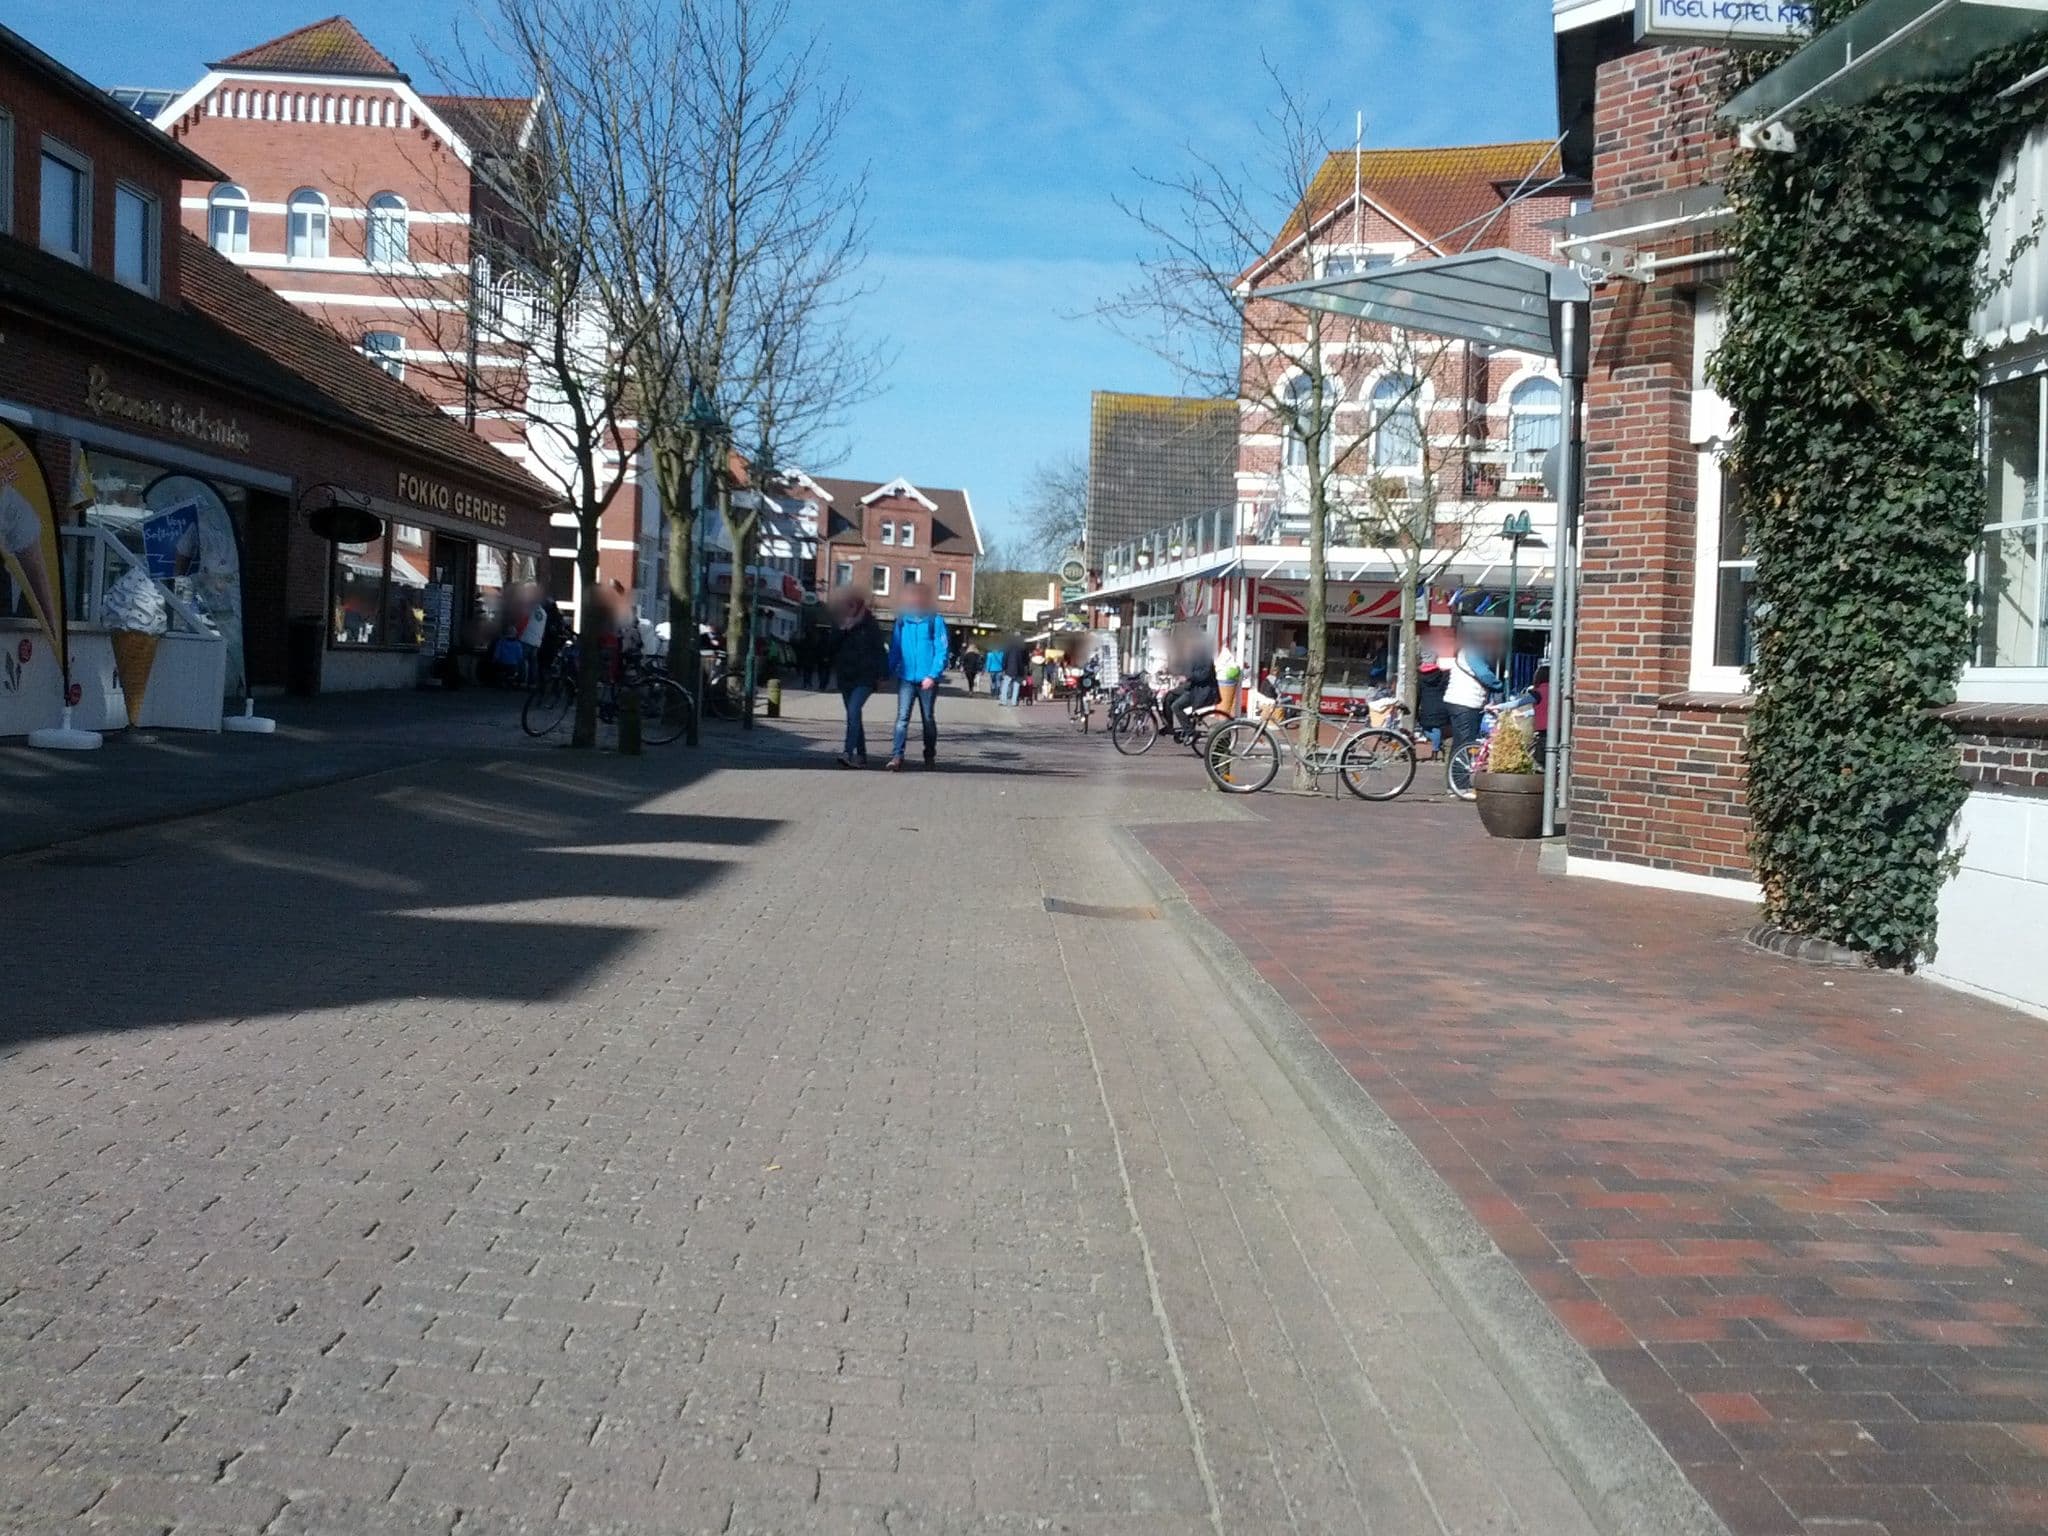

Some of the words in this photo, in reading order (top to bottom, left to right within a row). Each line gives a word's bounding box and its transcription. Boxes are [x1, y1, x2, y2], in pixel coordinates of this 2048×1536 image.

[1713, 1, 1774, 23] HOTEL
[398, 472, 449, 509] FOKKO
[454, 492, 506, 526] GERDES
